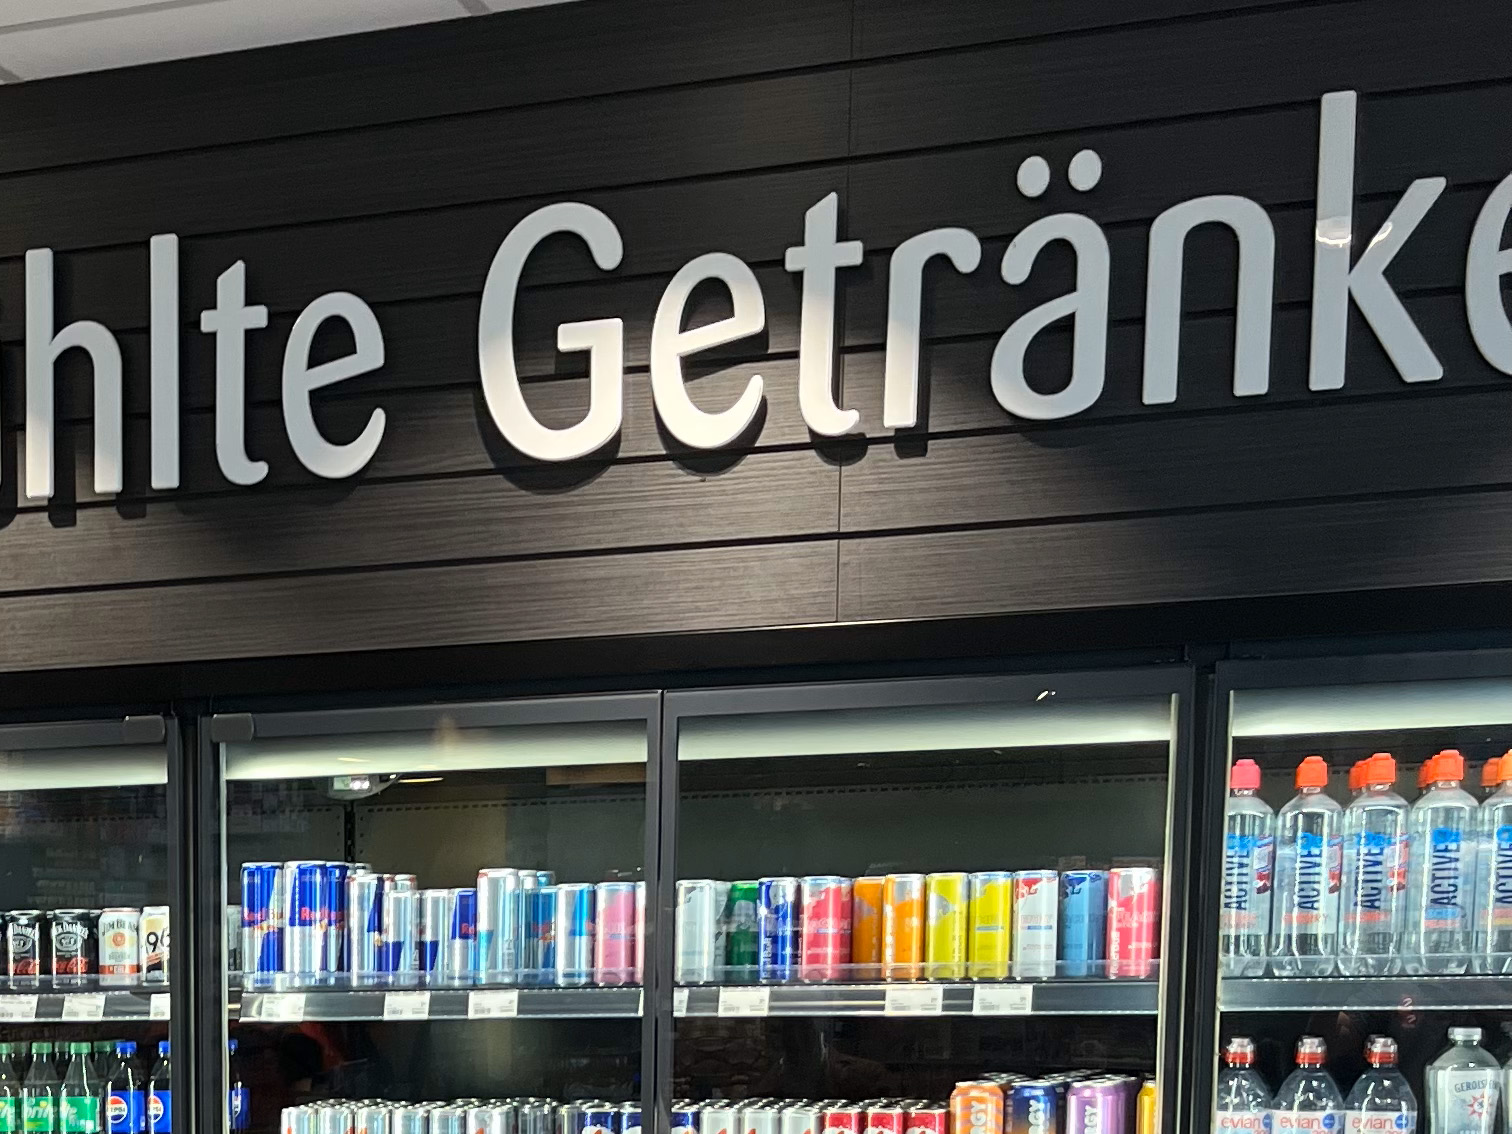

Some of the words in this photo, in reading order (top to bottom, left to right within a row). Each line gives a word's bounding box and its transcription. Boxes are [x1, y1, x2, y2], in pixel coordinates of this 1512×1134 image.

[1221, 1114, 1262, 1129] evian
[1280, 1114, 1321, 1129] evian
[1352, 1114, 1393, 1129] evian
